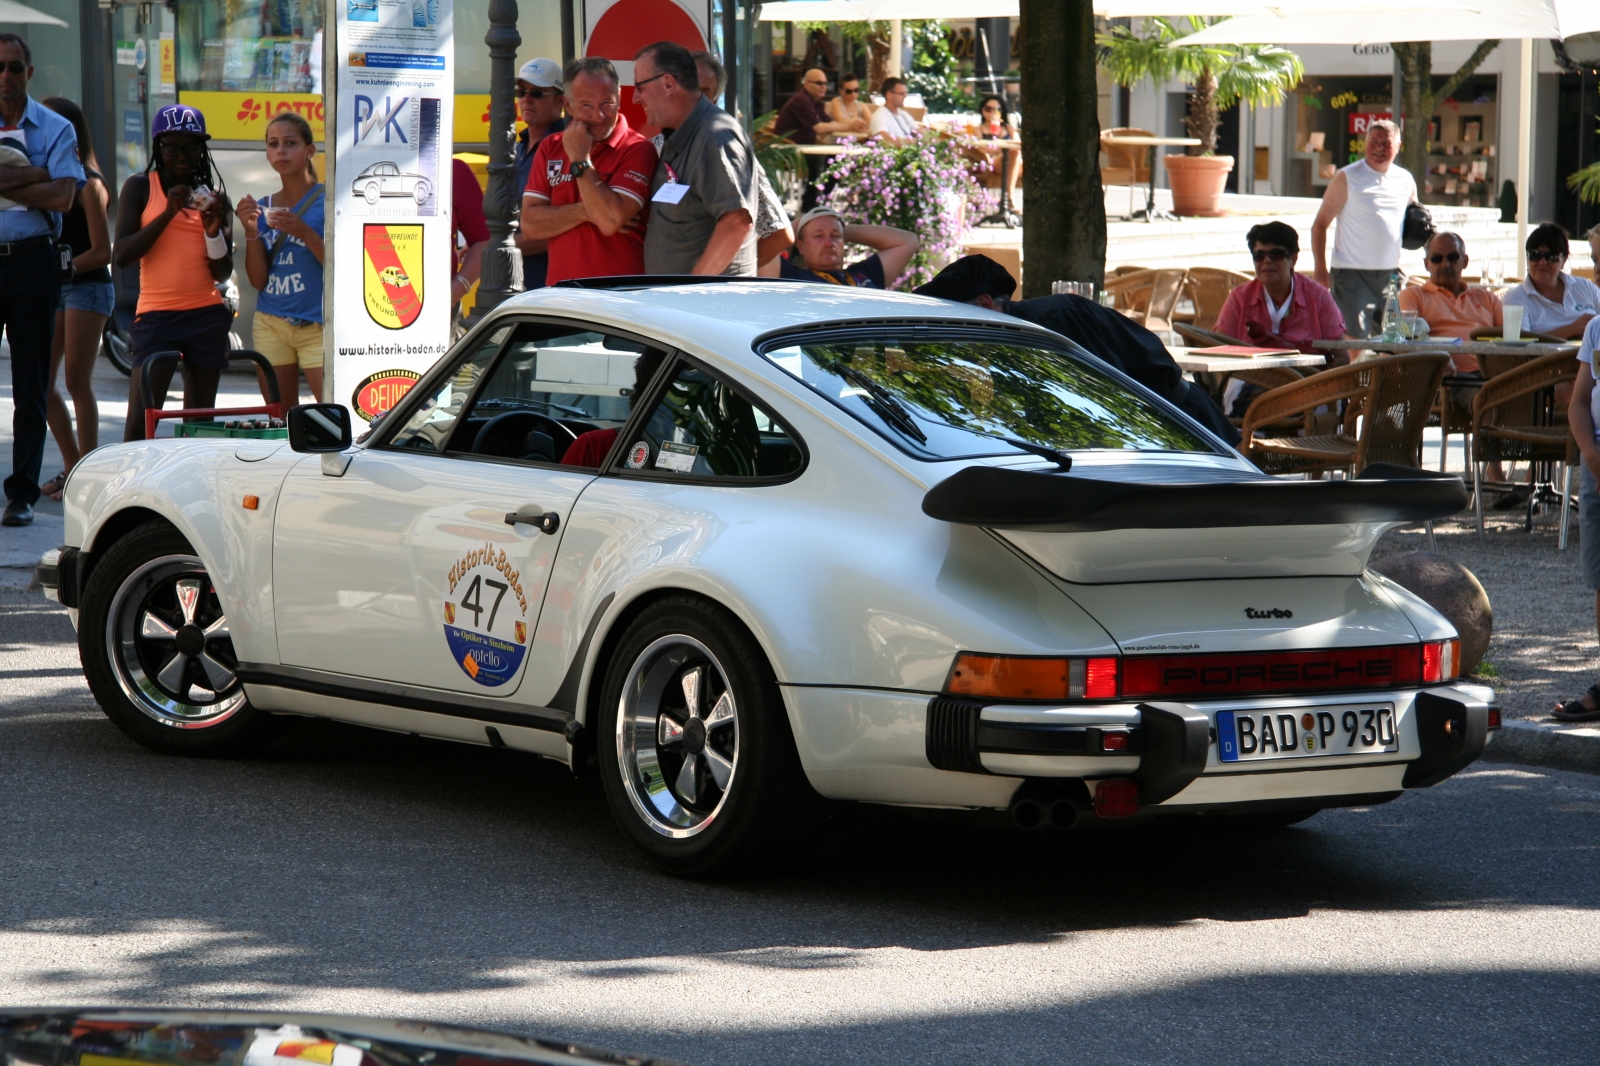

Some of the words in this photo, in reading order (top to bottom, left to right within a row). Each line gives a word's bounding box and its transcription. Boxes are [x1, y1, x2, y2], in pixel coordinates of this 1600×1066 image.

[1330, 90, 1358, 110] 60%
[163, 107, 202, 132] LA
[410, 97, 420, 151] WORKSHOP
[278, 251, 293, 265] LA
[339, 343, 446, 356] www.historik-baden.de
[461, 574, 508, 632] 47
[1245, 607, 1293, 619] turbo
[461, 630, 482, 643] Optiker
[488, 638, 515, 653] Sinzheim
[1163, 658, 1393, 687] PORSCHE
[1225, 741, 1232, 753] D
[1237, 714, 1299, 755] BAD
[1317, 711, 1336, 749] P
[1342, 708, 1395, 748] 930
